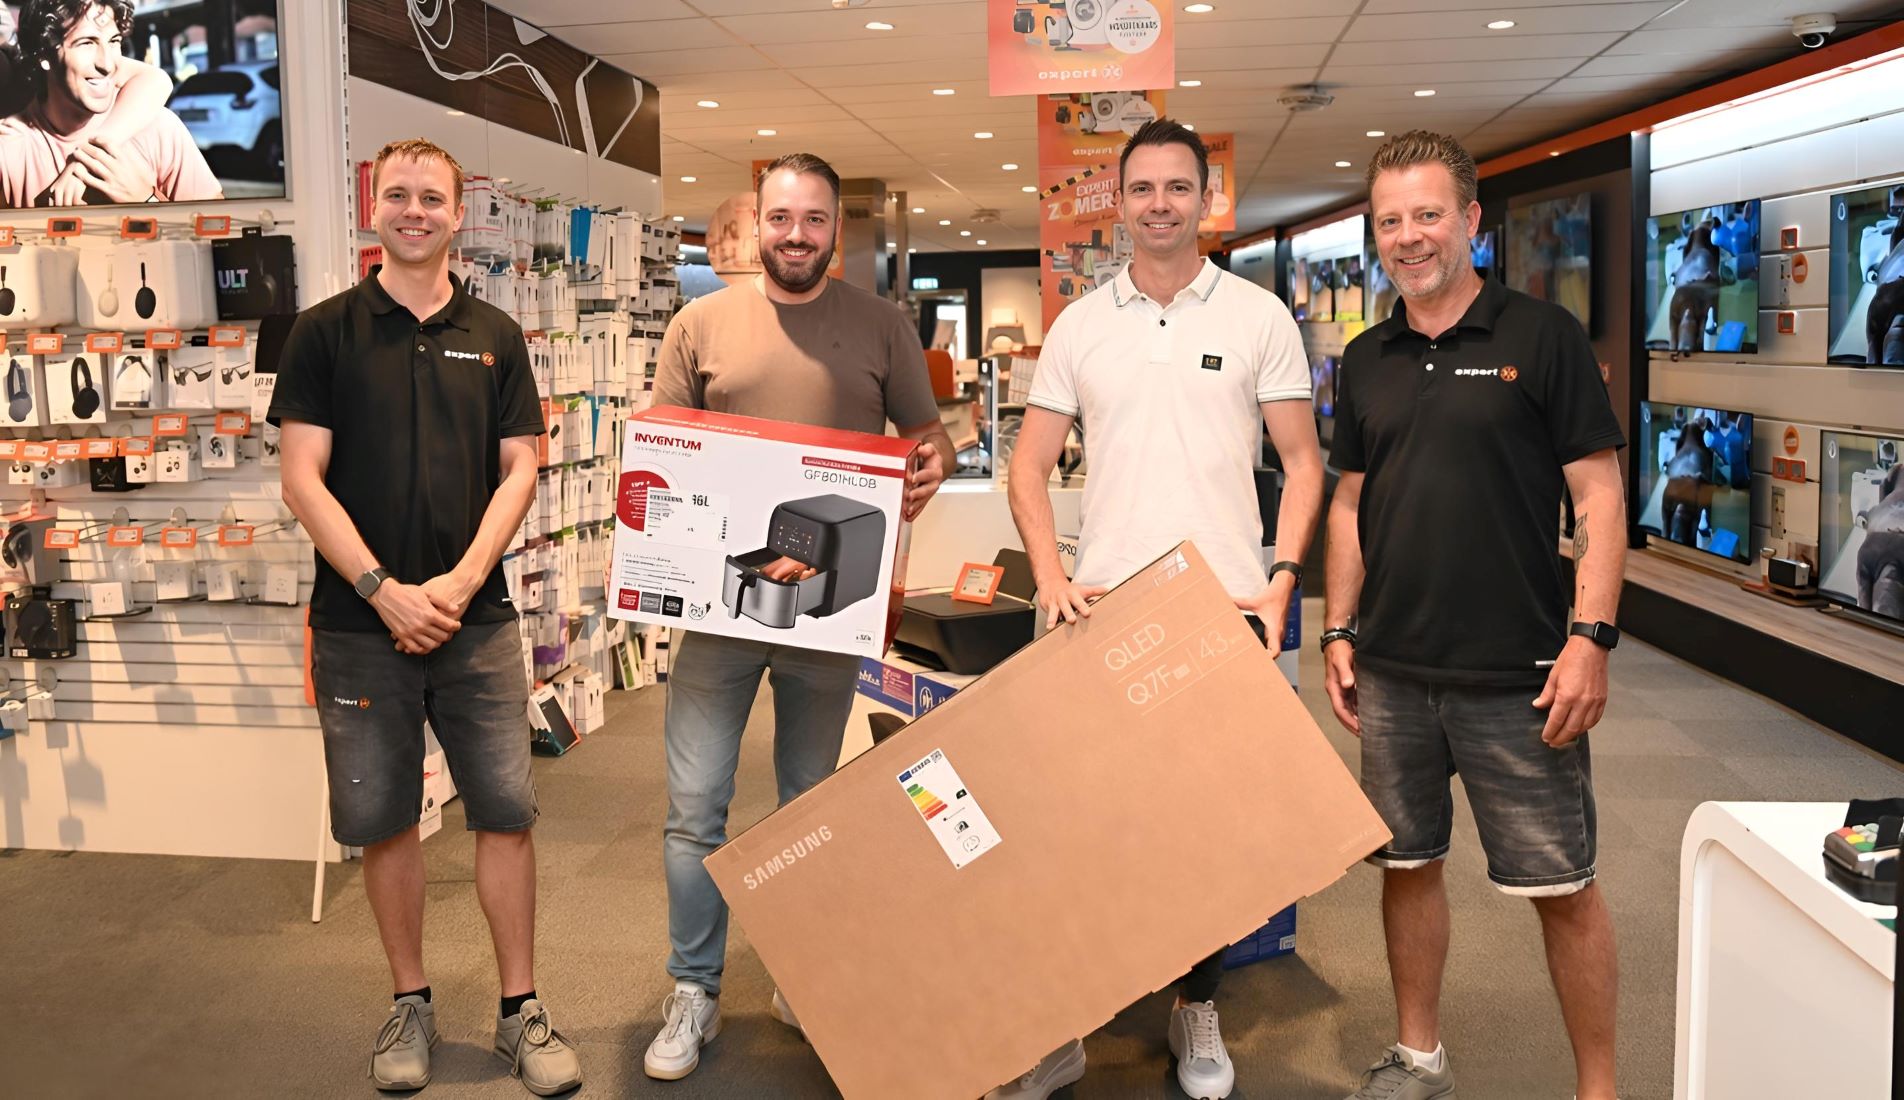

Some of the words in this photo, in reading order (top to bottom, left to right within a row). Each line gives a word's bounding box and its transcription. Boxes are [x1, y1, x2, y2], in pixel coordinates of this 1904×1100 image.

[1038, 68, 1097, 80] expert
[217, 269, 249, 289] ULT
[1454, 368, 1498, 376] expert
[634, 432, 702, 451] INVENTUM
[1104, 623, 1166, 671] QLED
[1127, 663, 1174, 705] Q7F
[1200, 630, 1228, 658] 43
[743, 825, 833, 890] SAMSUNG
